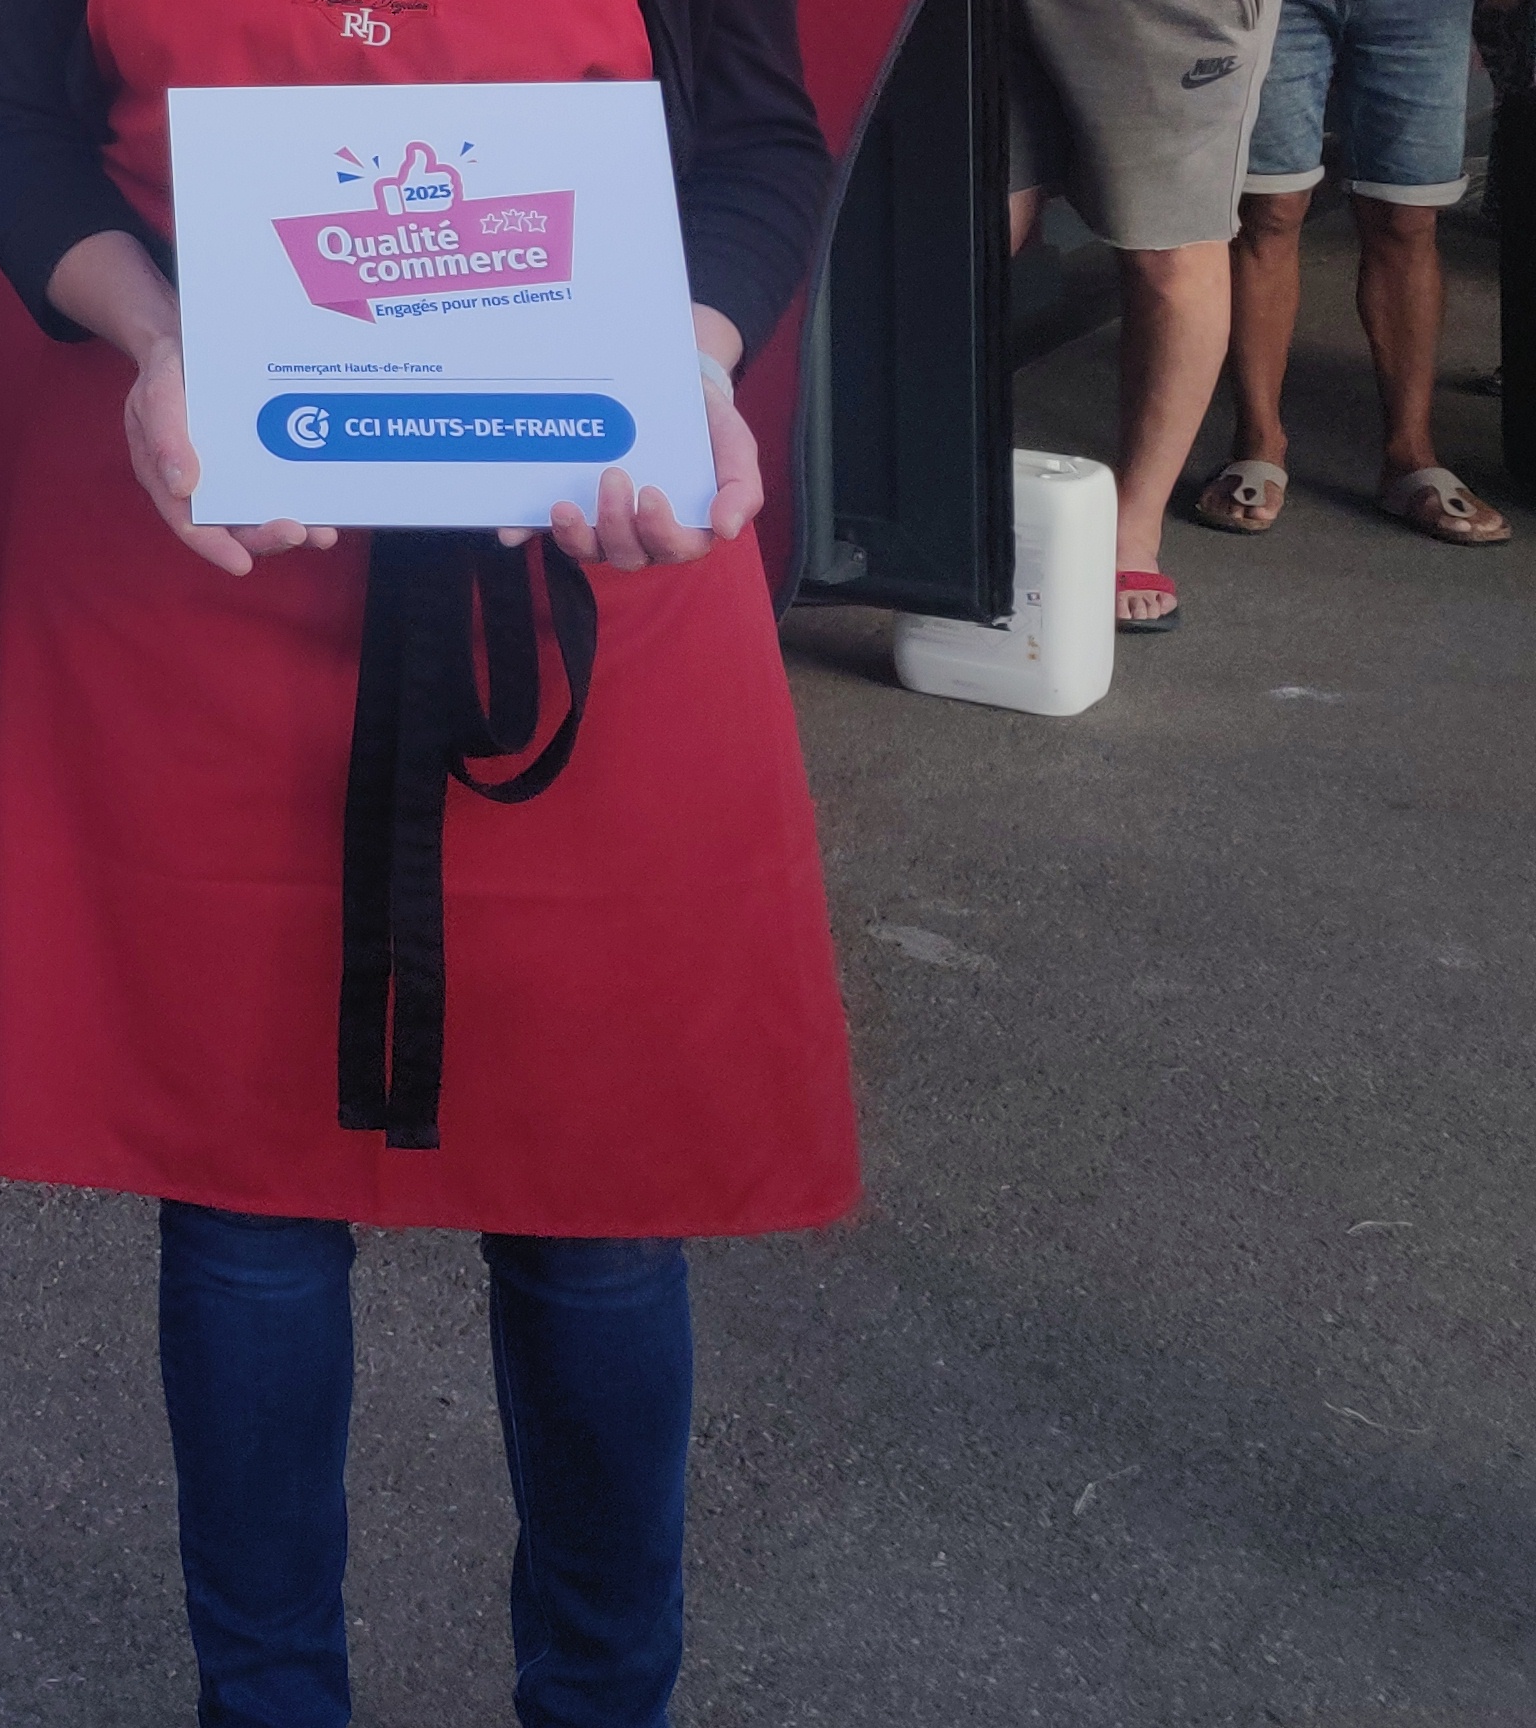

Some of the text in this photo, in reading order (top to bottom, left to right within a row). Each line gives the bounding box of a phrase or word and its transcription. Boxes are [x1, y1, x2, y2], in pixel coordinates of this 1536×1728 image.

[403, 184, 452, 202] 2025
[317, 220, 460, 265] Qualité
[359, 245, 548, 283] commerce
[375, 298, 438, 317] Engagés
[442, 297, 478, 314] pour
[481, 294, 510, 308] nos
[513, 288, 564, 305] clients
[267, 362, 443, 376] Commerçant Hauts-de-France
[344, 417, 606, 438] CCI HAUTS-DE-FRANCE
